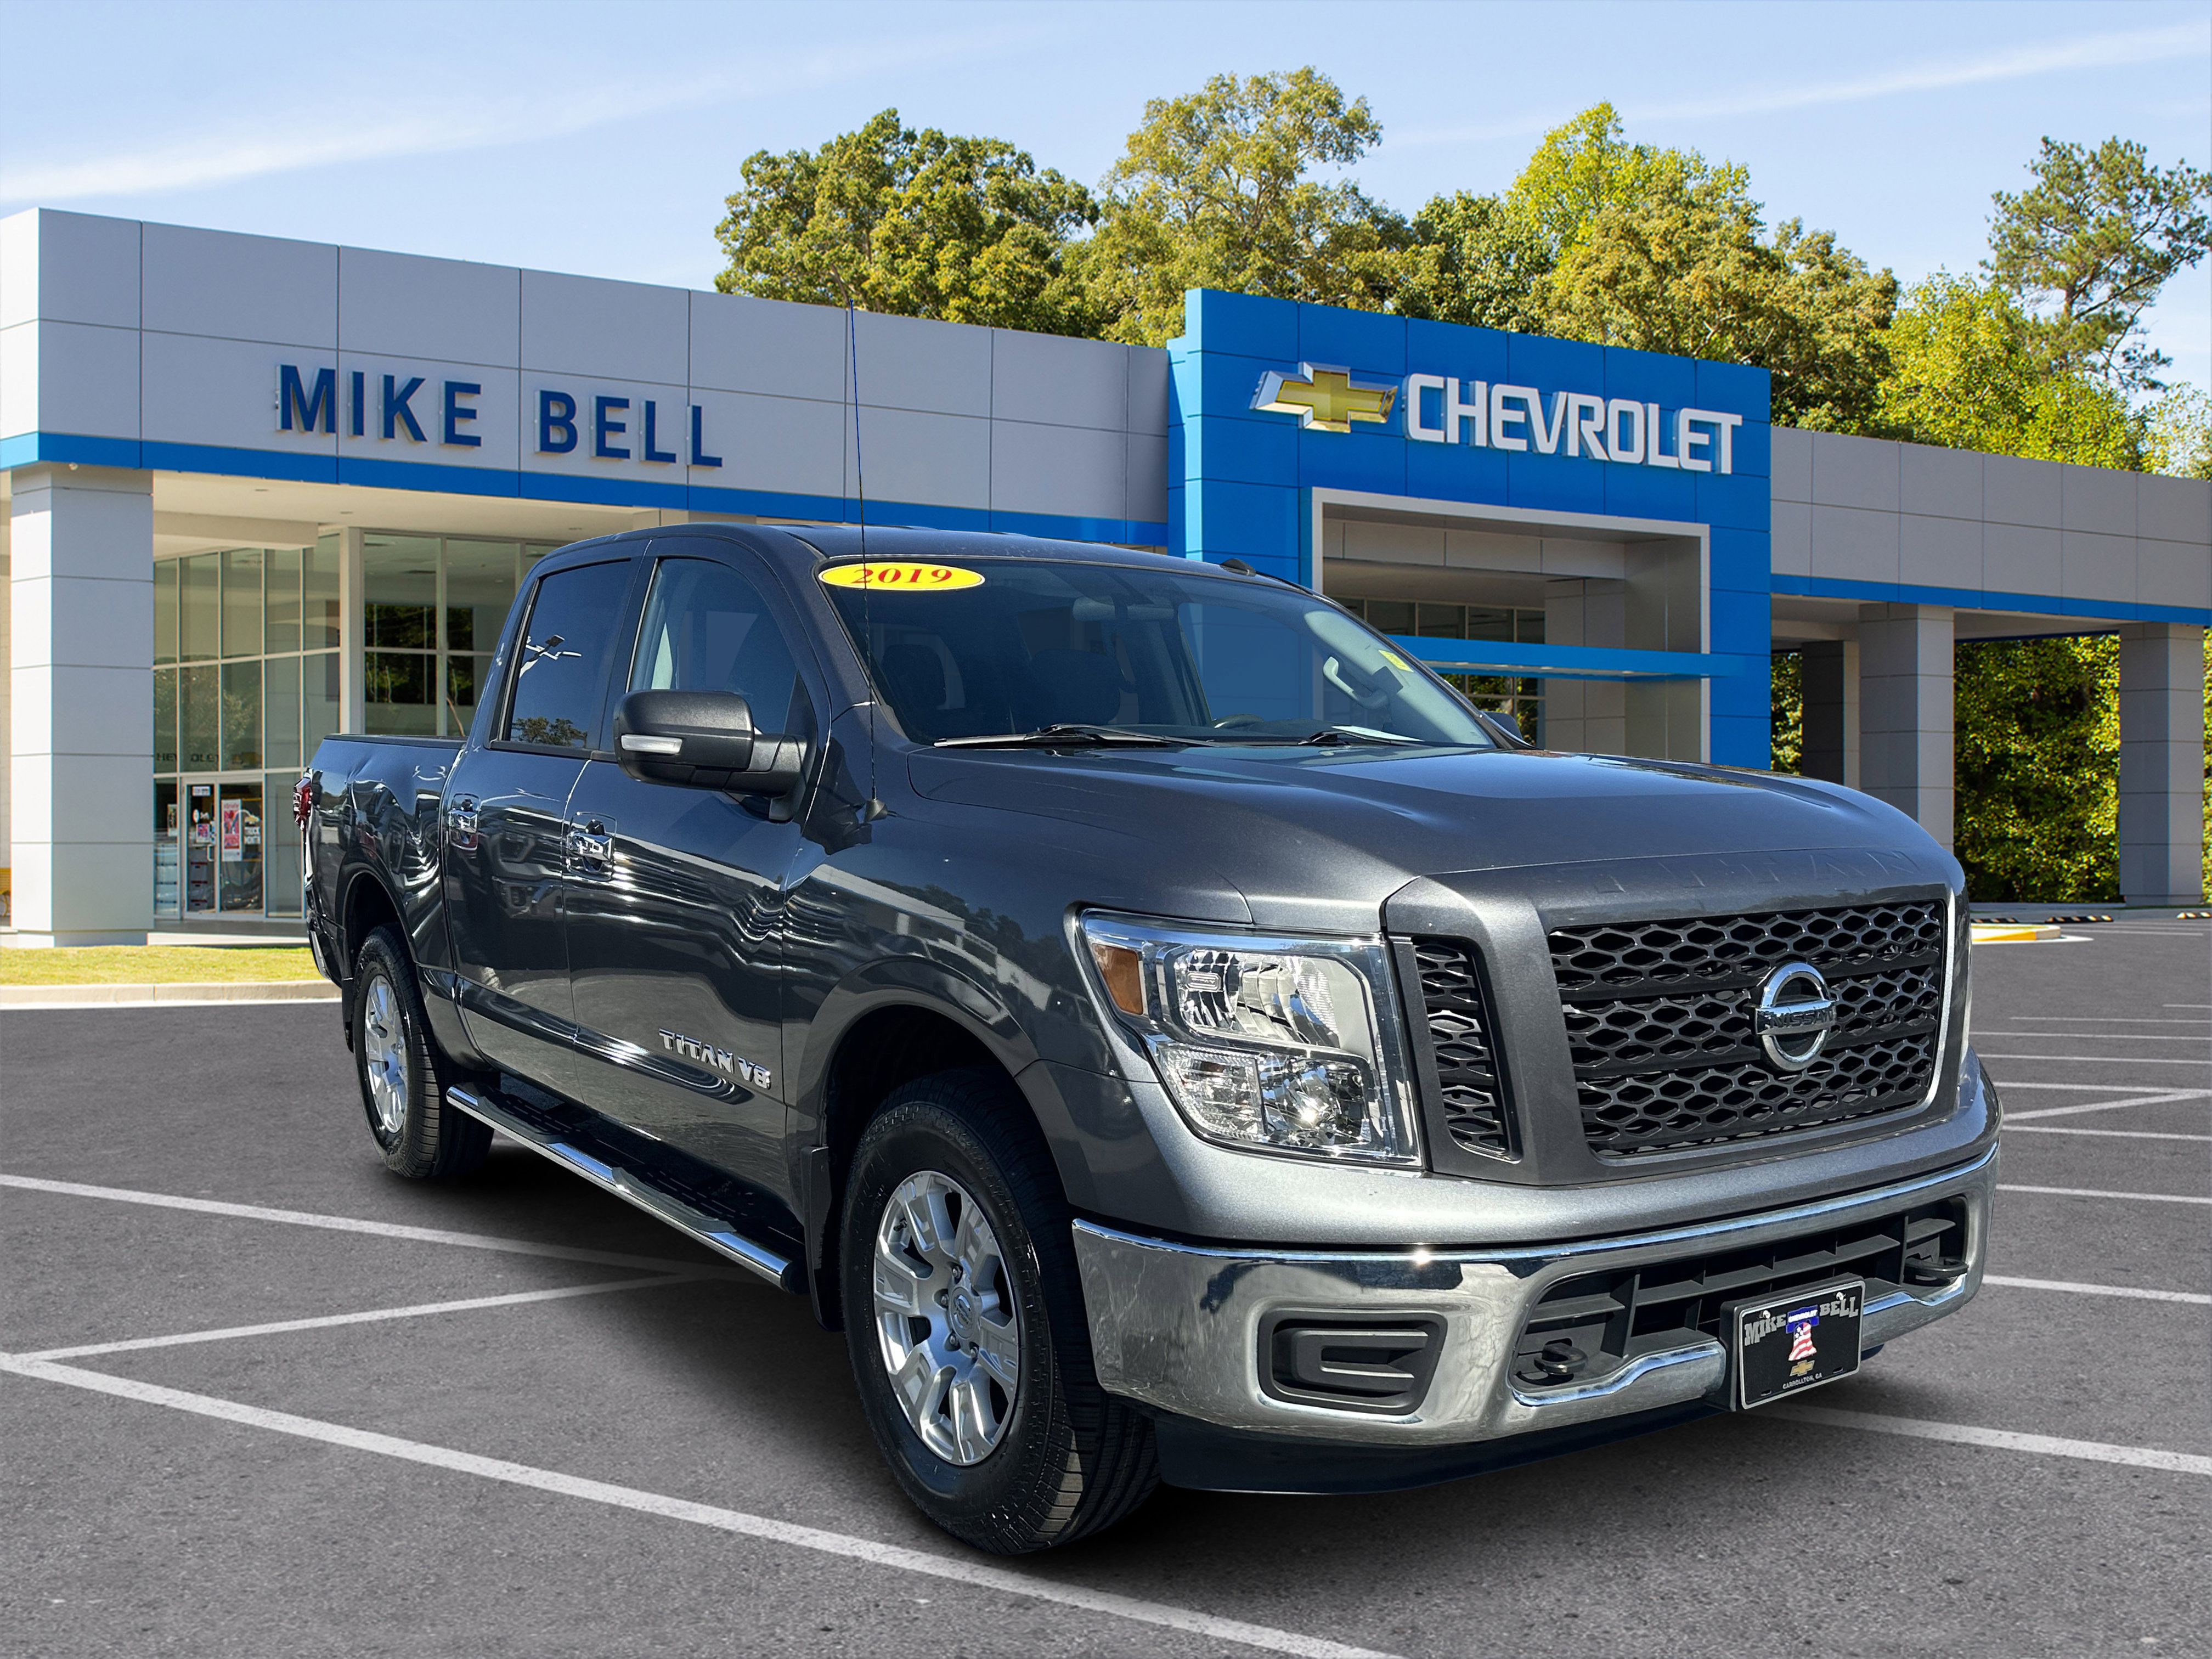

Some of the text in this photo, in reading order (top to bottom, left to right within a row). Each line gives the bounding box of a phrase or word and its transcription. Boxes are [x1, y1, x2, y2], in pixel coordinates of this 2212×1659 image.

[276, 364, 723, 468] MIKE BELL
[1404, 373, 1742, 475] CHEVROLET
[851, 568, 952, 584] 2019
[1768, 1008, 1834, 1028] NISSAN
[659, 1028, 771, 1090] TITAN V8
[1745, 1296, 1859, 1346] MIKE BELL
